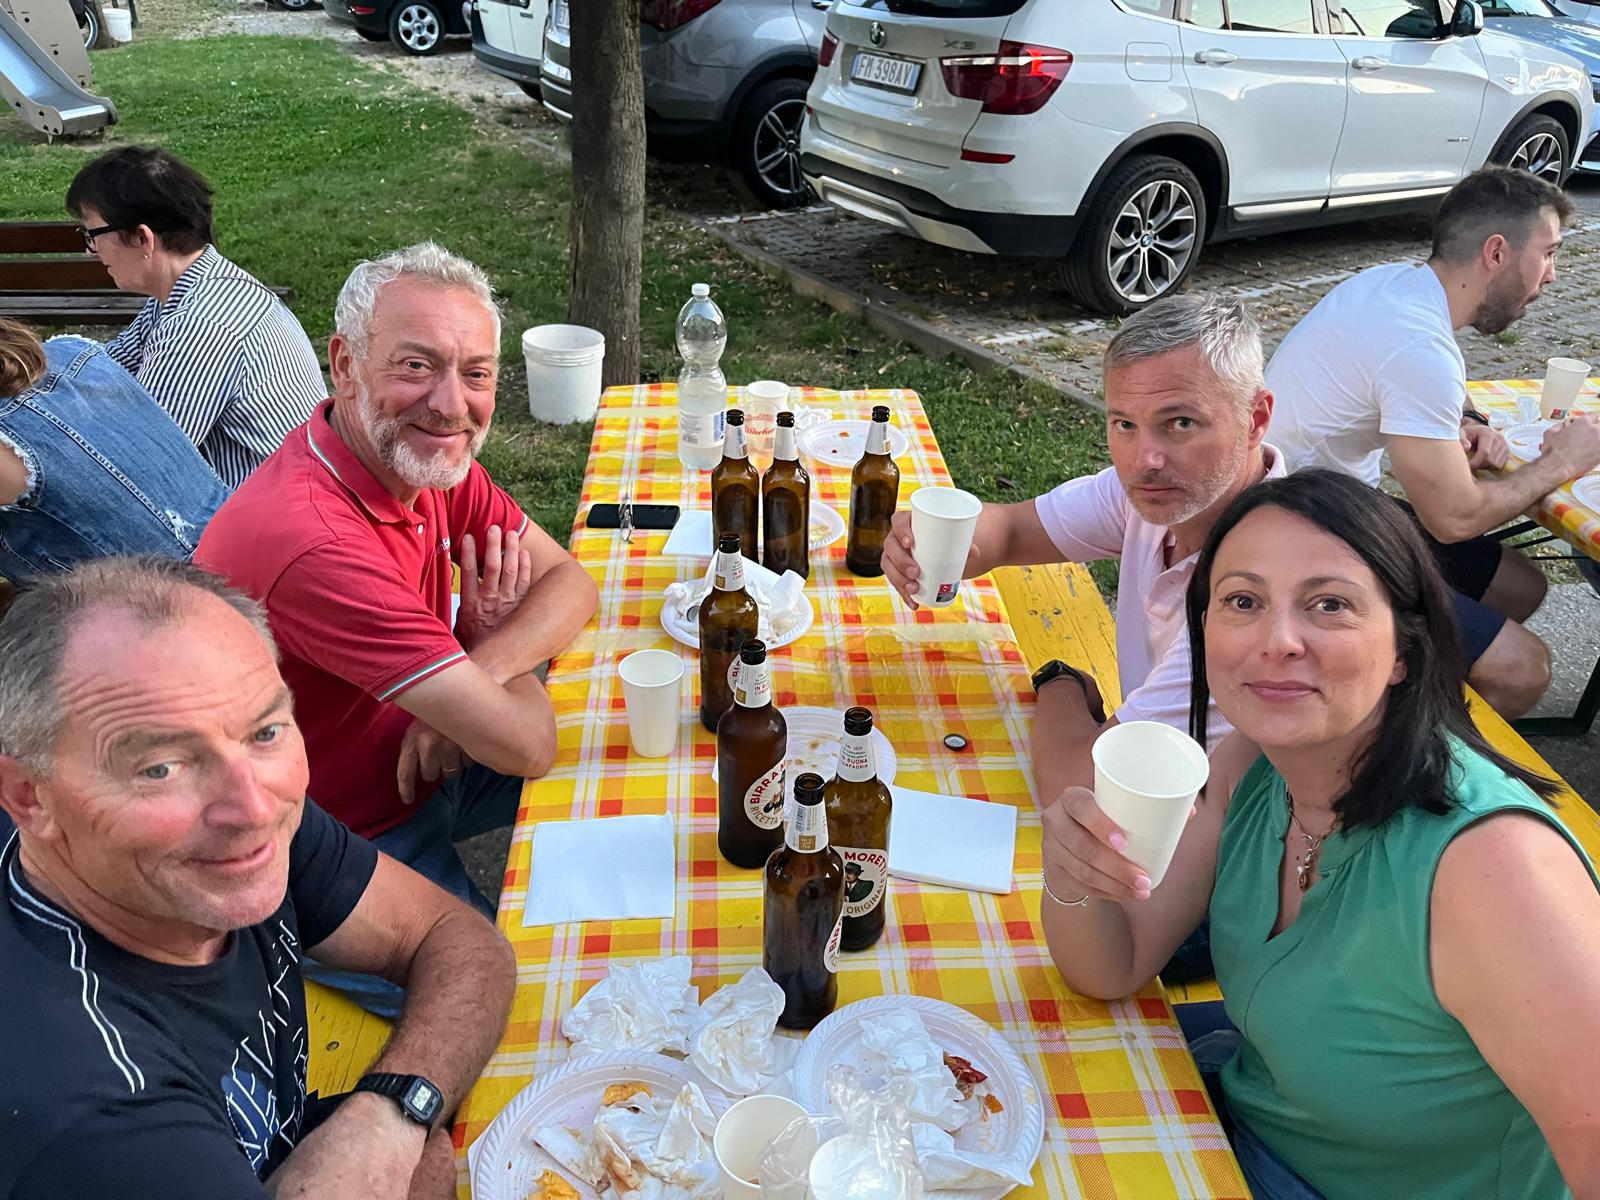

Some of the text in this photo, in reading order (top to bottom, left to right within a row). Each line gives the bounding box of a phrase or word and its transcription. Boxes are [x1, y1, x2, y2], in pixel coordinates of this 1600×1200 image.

[943, 39, 977, 51] X3
[750, 771, 779, 804] BIRRA
[750, 805, 780, 825] RICETTA
